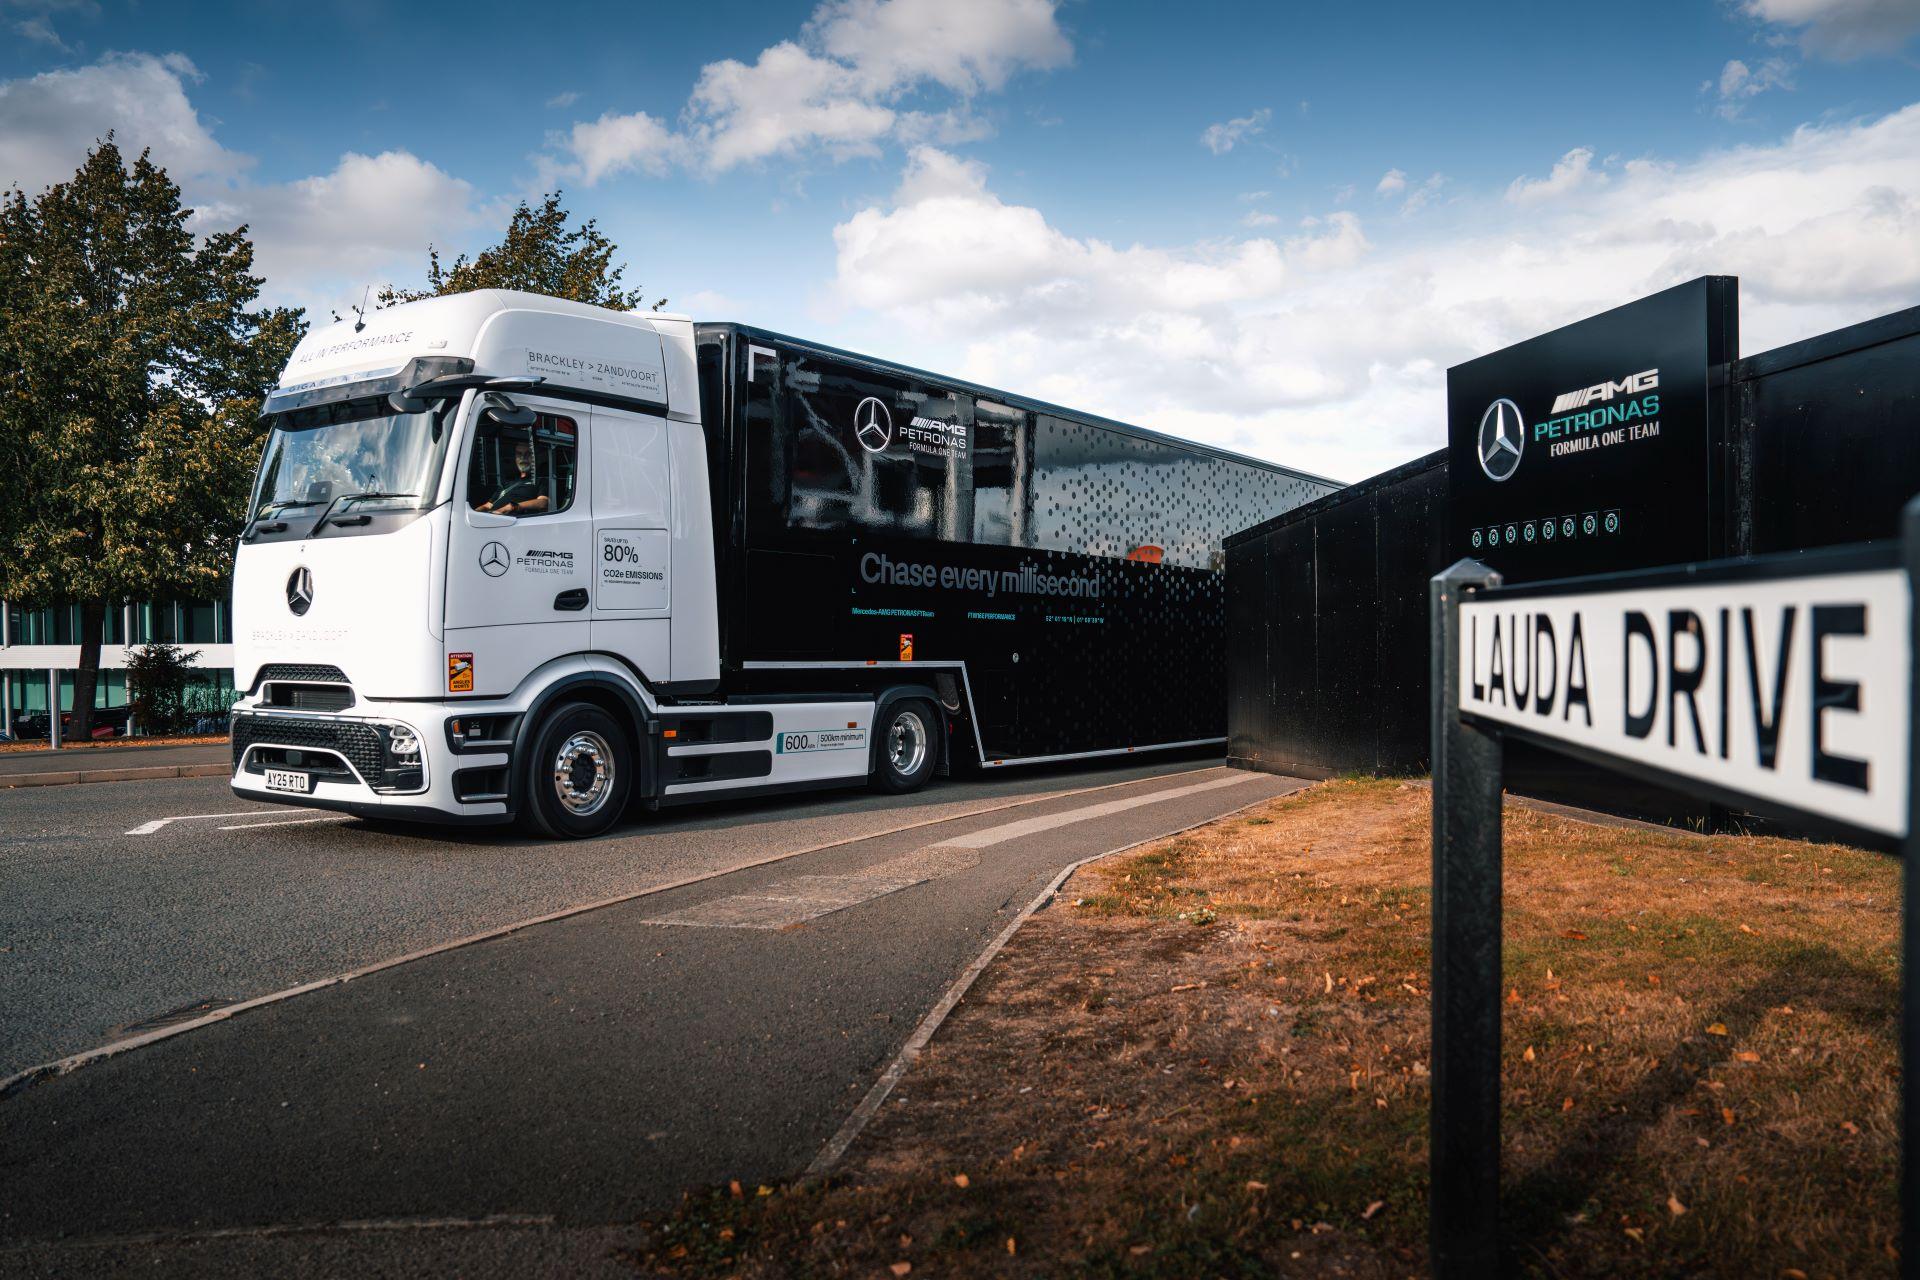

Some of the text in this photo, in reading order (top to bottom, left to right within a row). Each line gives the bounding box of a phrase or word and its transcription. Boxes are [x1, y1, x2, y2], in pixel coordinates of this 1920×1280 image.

[328, 331, 413, 356] PERFORMANCE
[529, 351, 584, 369] BRACKLEY
[597, 363, 657, 383] ZANDVOORT
[1583, 368, 1659, 405] AMG
[928, 419, 967, 436] AMG
[1534, 395, 1660, 441] PETRONAS
[900, 426, 967, 449] PETRONAS
[1550, 421, 1660, 457] FORMULA ONE TEAM
[909, 441, 967, 459] FORMULA ONE TEAM
[516, 557, 574, 568] PETRONAS
[541, 551, 573, 559] AMG
[604, 544, 638, 564] 80%
[603, 569, 664, 581] CO2e EMISSIONS
[860, 552, 1100, 598] Chase every millisecond
[1472, 603, 1871, 794] LAUDA DRIVE
[785, 734, 808, 750] 600
[268, 772, 305, 789] AY25 RTO
